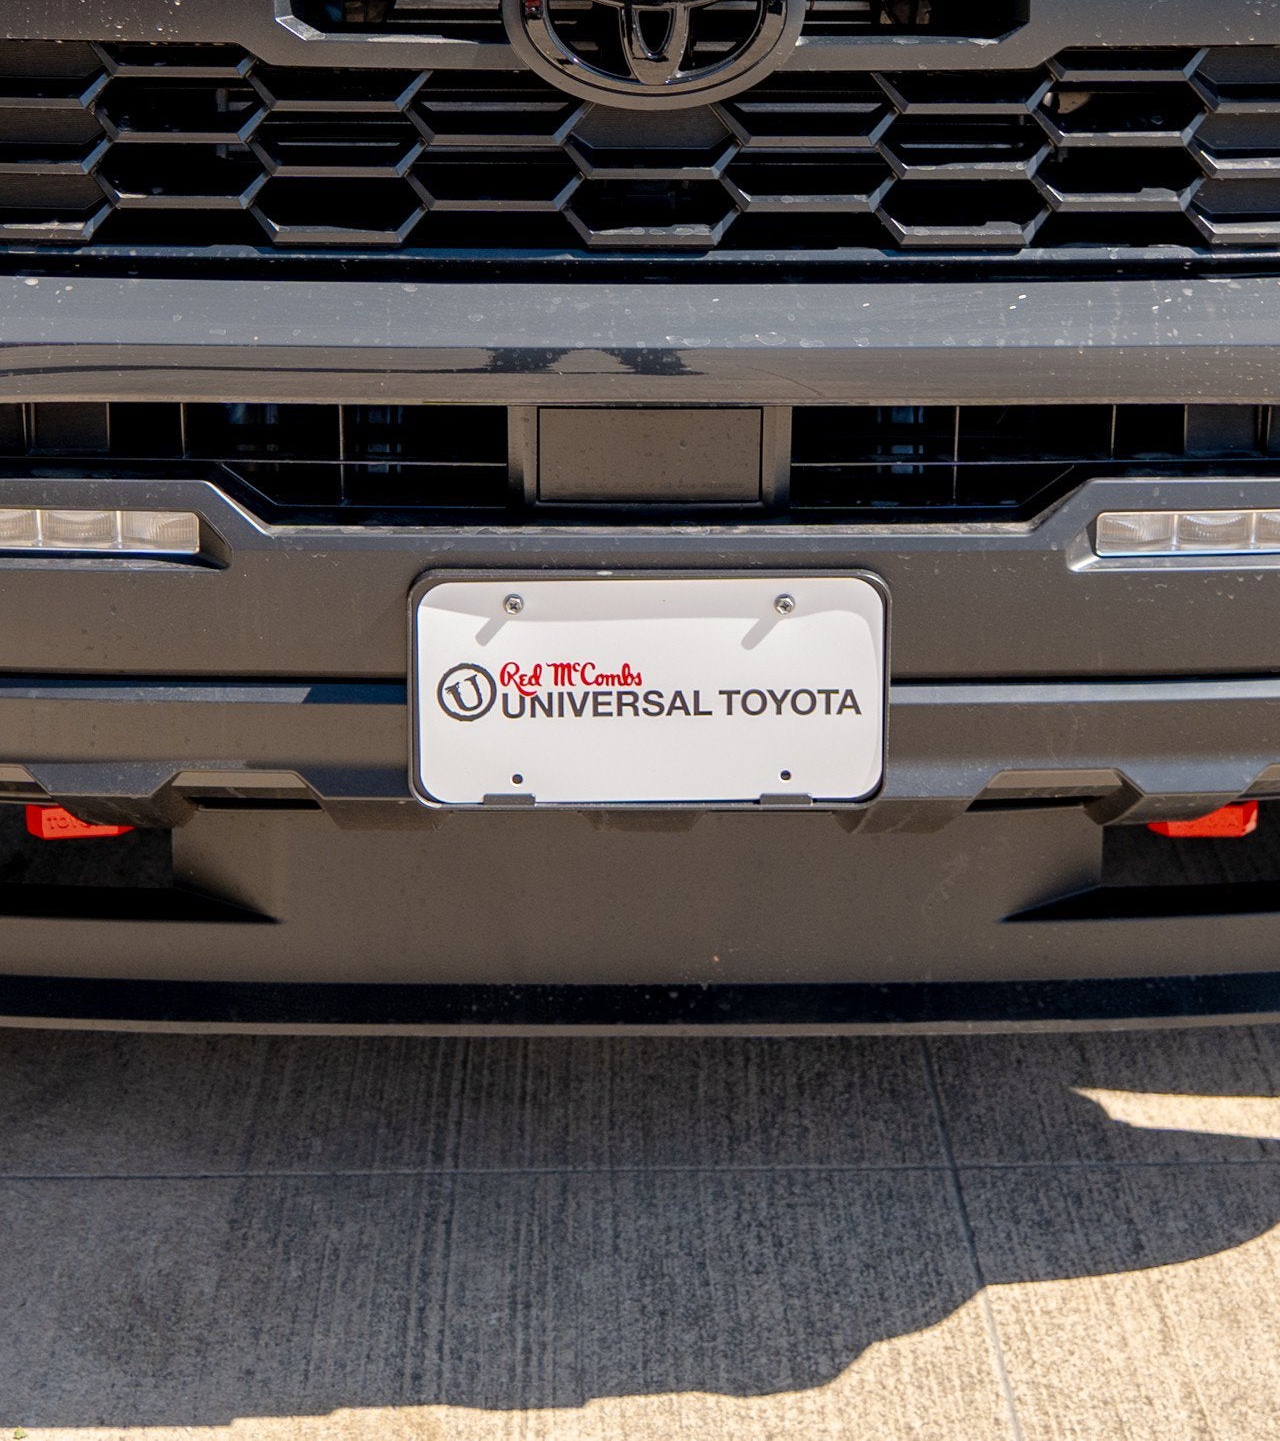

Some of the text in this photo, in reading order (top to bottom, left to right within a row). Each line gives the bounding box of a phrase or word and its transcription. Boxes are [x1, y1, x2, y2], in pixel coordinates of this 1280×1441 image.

[499, 661, 643, 696] Red McCombs
[501, 688, 862, 719] UNIVERSAL TOYOTA
